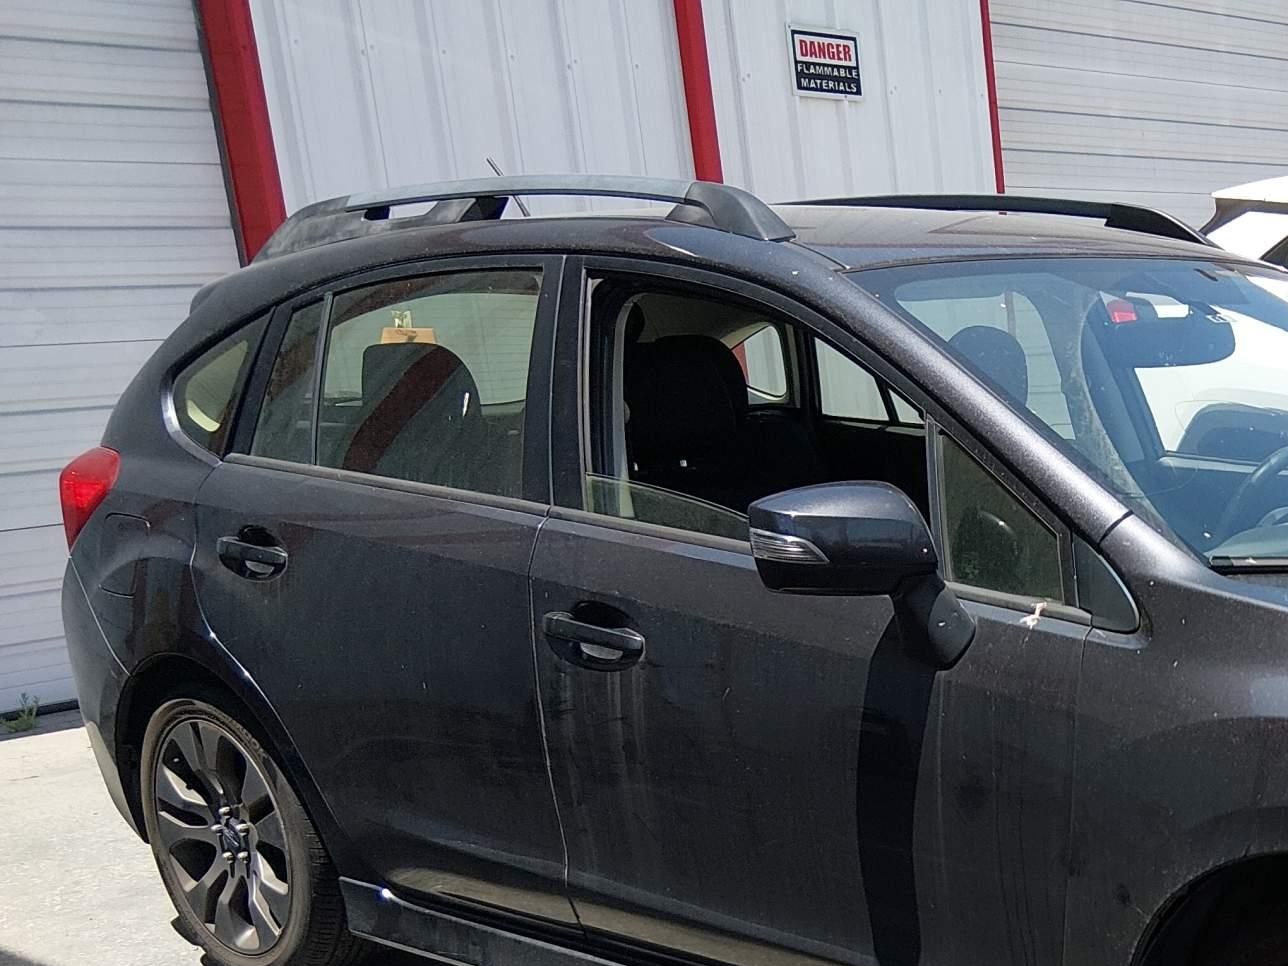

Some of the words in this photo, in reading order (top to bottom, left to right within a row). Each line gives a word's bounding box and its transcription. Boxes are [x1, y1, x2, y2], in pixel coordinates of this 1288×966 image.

[799, 39, 852, 62] DANGER
[797, 63, 858, 79] FLAMMABLE
[800, 77, 857, 92] MATERIALS
